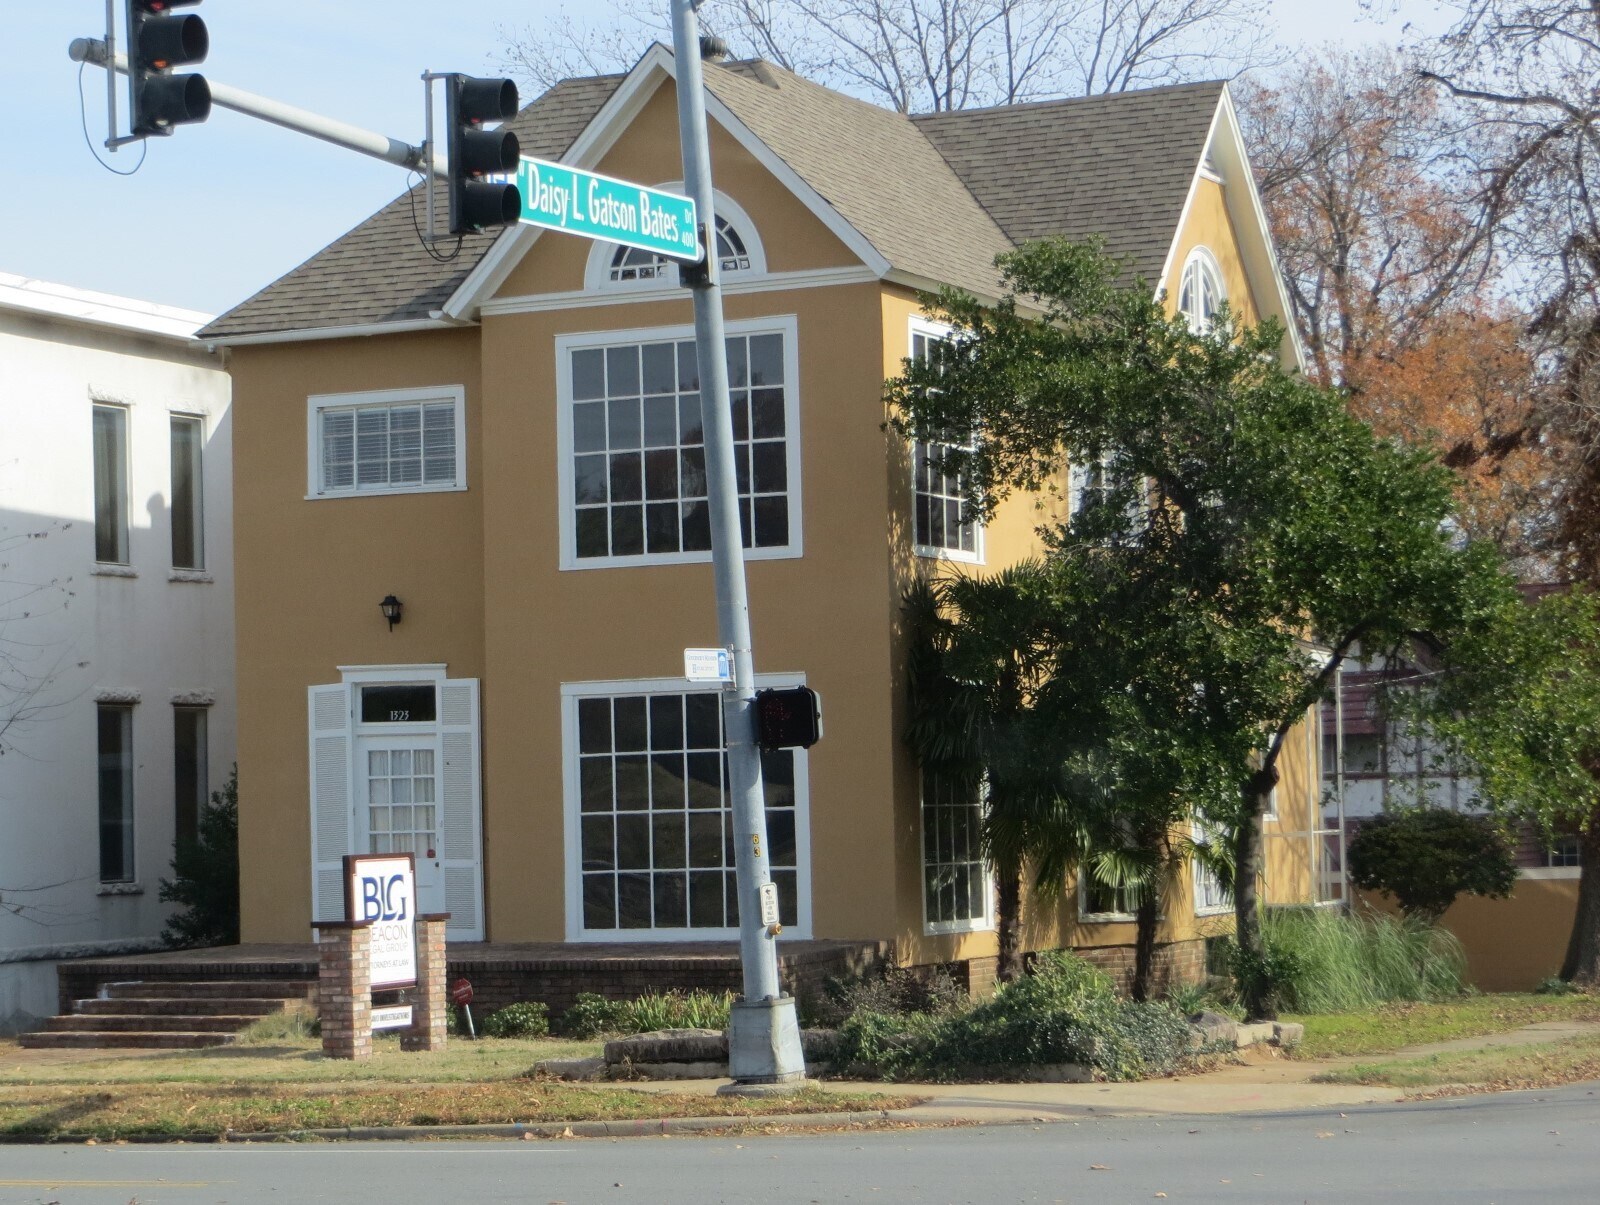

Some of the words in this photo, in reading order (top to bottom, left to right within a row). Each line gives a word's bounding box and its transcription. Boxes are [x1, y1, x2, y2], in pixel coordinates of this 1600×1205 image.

[518, 162, 525, 177] W
[528, 163, 569, 227] Daisy
[572, 174, 585, 222] L.
[588, 178, 637, 233] Gatson
[640, 191, 679, 242] Bates
[684, 208, 692, 225] Dr
[681, 232, 694, 249] 400
[390, 710, 409, 721] 1323
[362, 873, 407, 921] BLG
[371, 925, 408, 942] EACON
[386, 941, 408, 953] GROUP
